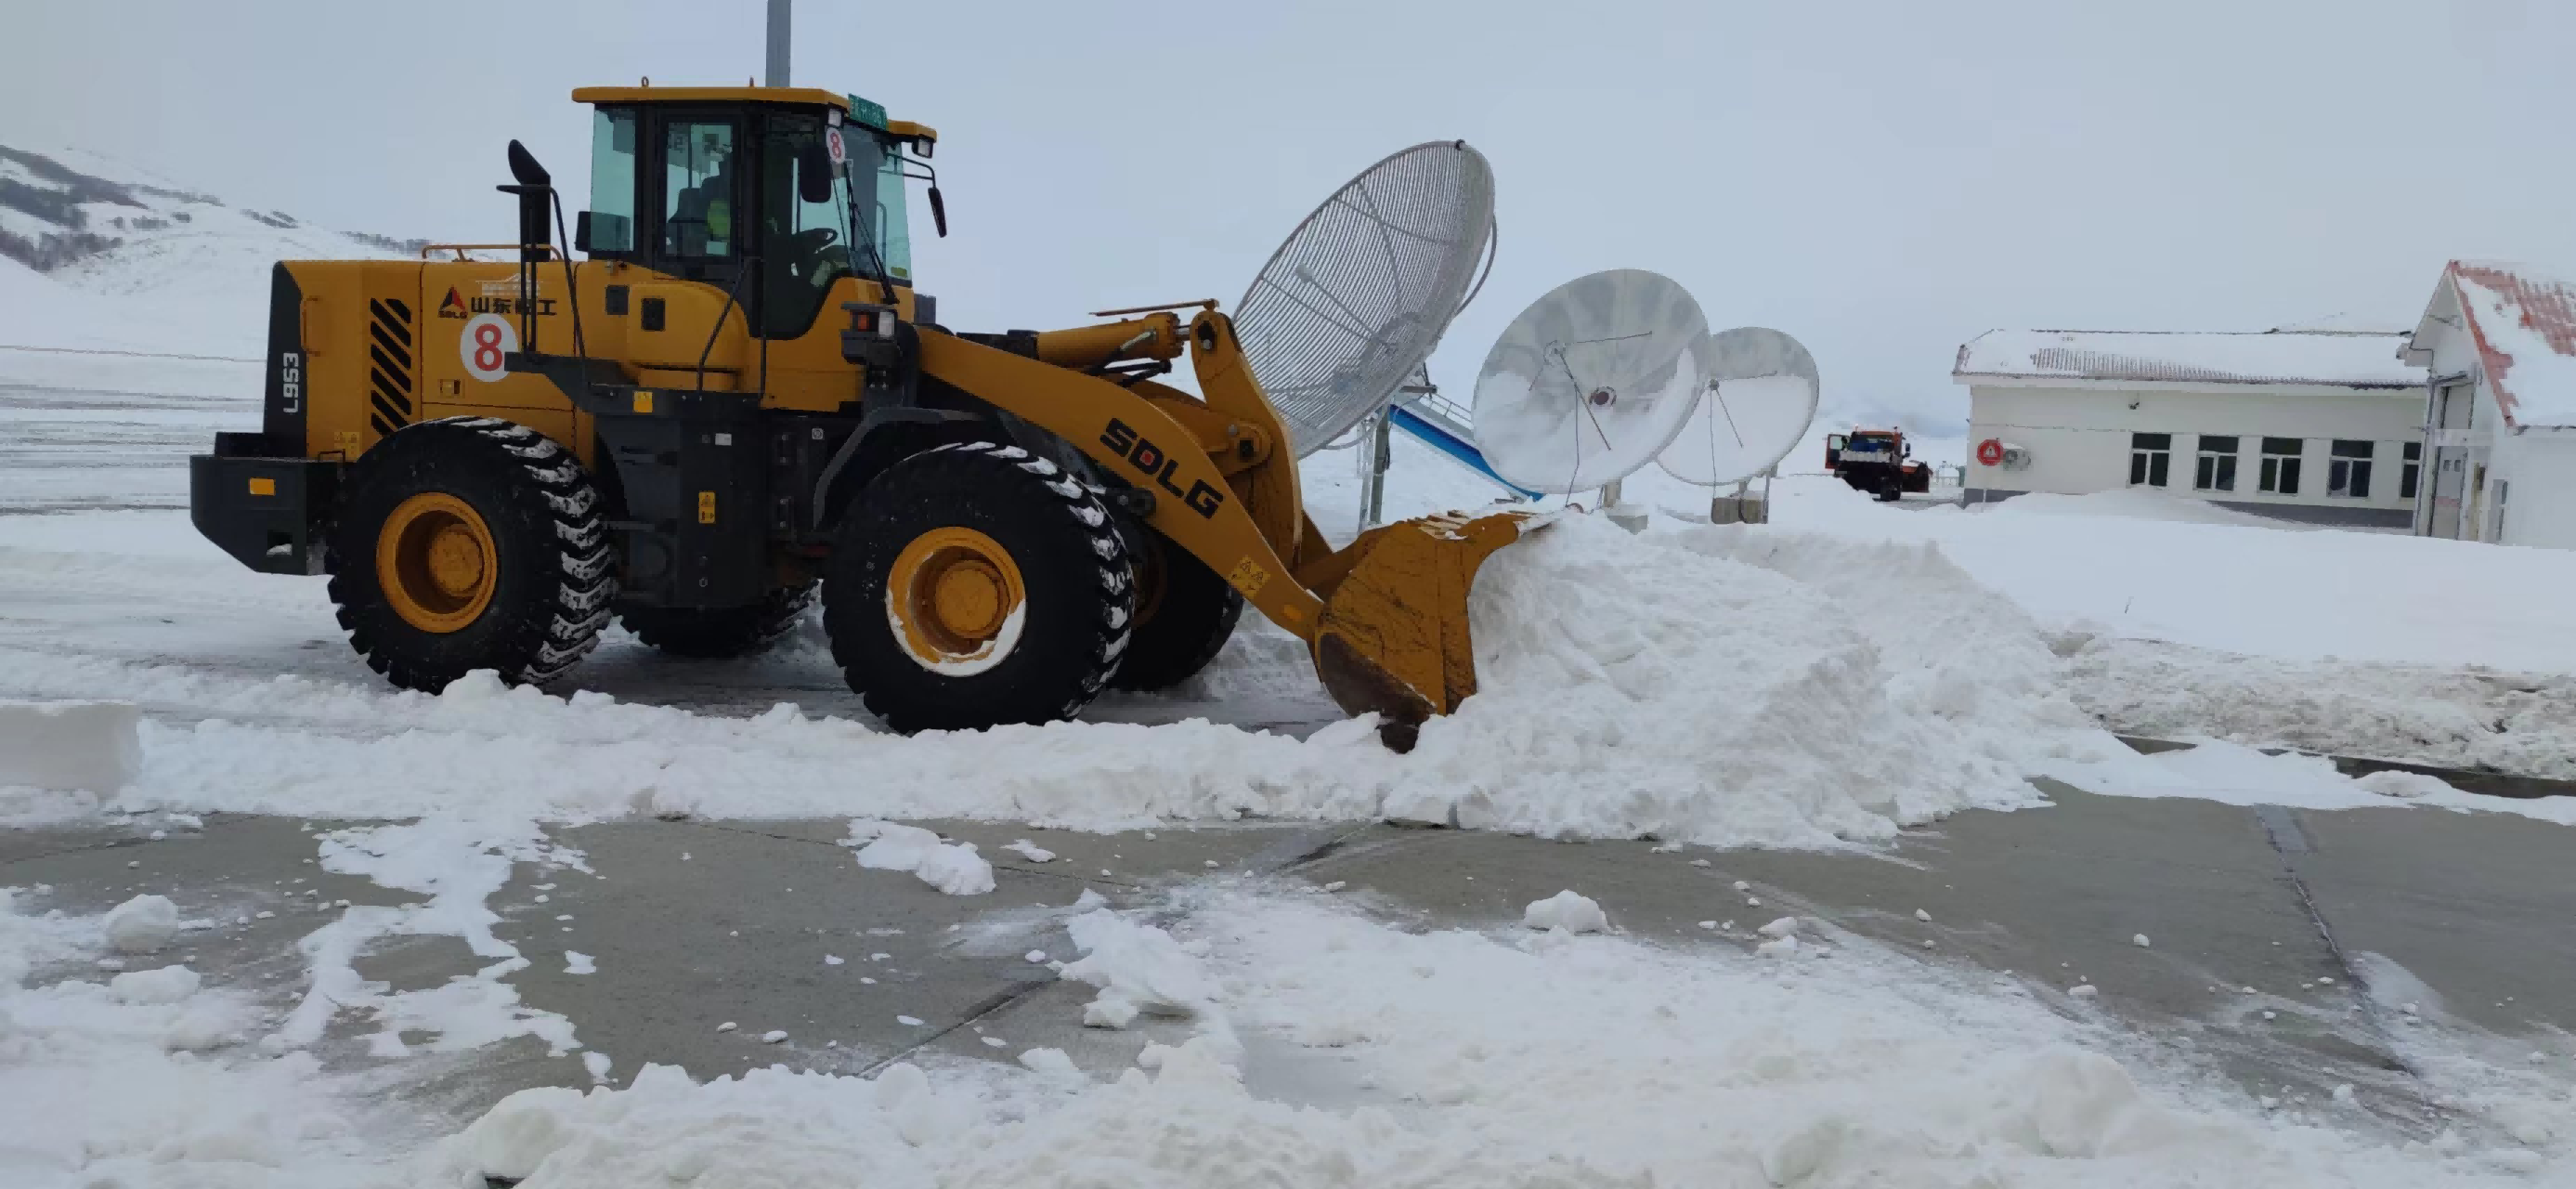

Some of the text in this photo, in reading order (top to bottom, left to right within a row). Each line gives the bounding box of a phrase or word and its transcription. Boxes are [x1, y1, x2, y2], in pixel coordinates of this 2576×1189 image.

[829, 132, 842, 160] 8
[475, 323, 502, 372] 8
[282, 352, 299, 413] L953
[1099, 417, 1224, 520] SDLG
